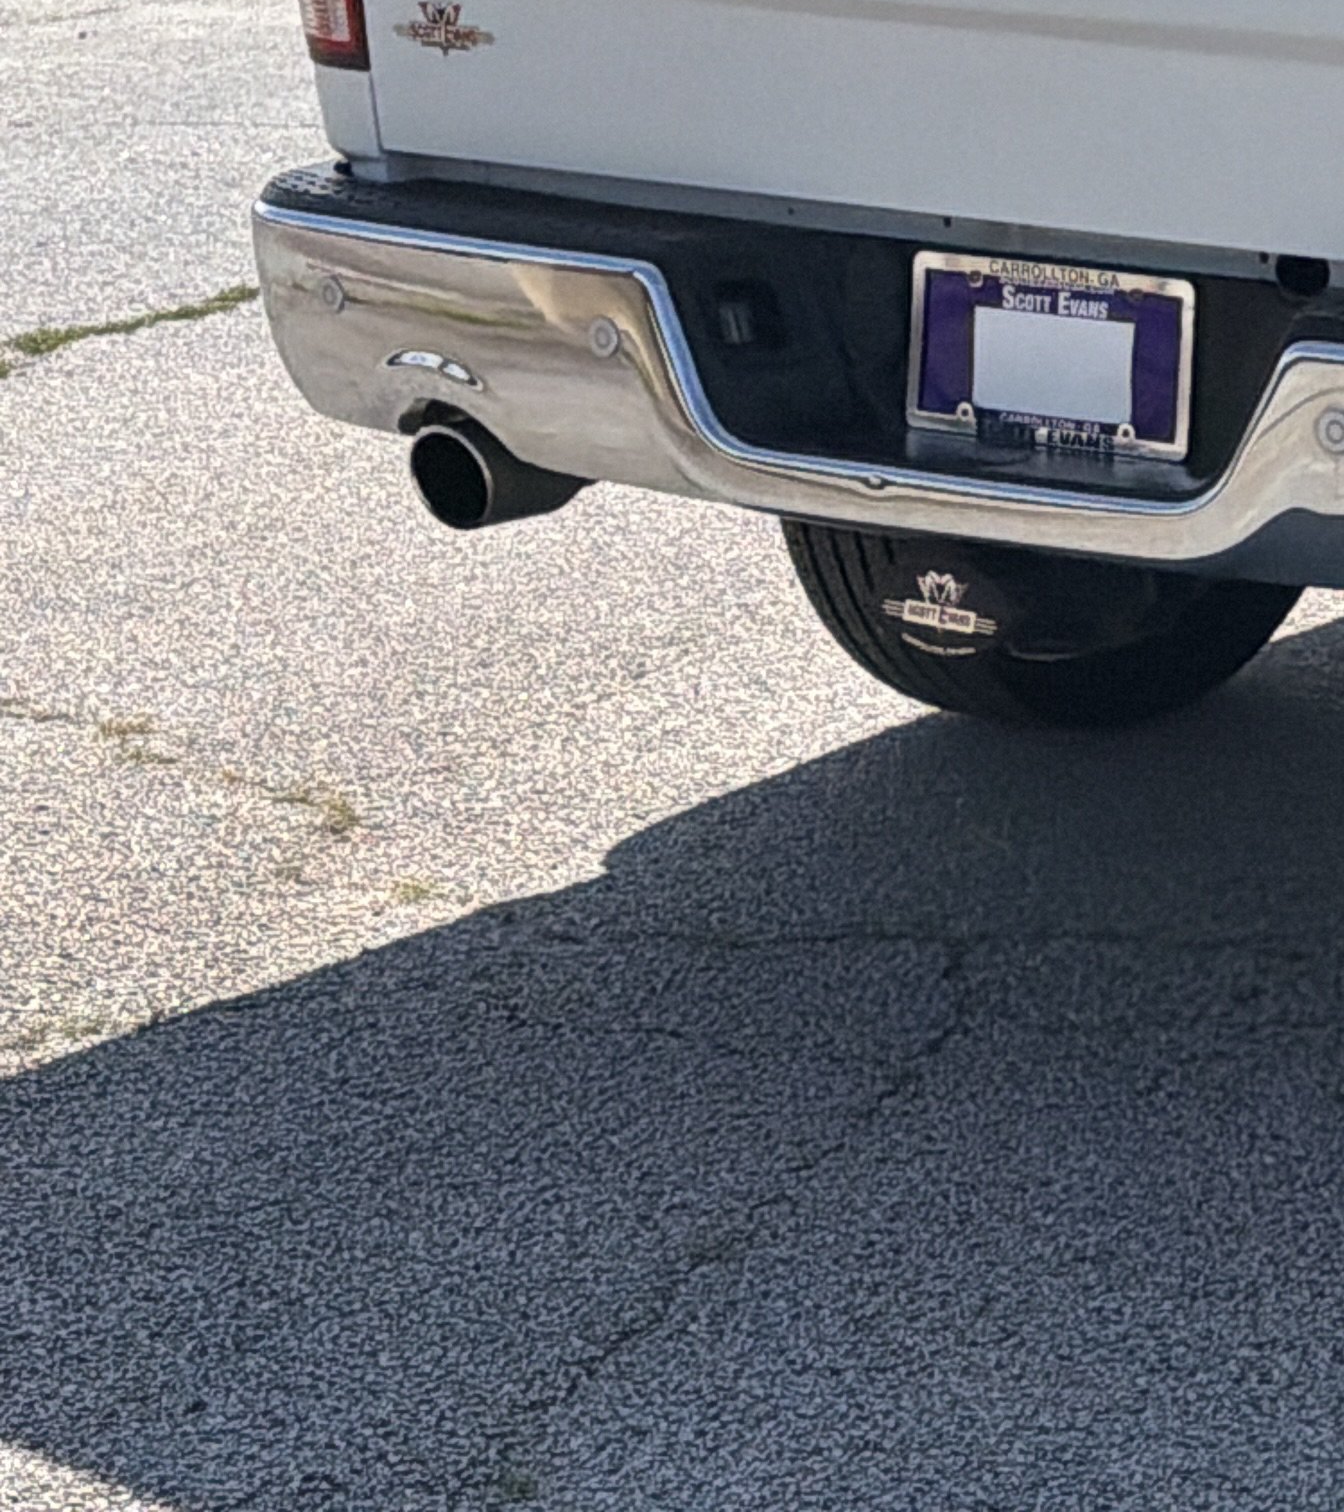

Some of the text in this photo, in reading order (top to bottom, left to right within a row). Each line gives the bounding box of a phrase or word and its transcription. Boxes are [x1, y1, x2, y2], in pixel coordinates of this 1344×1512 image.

[1096, 272, 1121, 288] GA
[1001, 284, 1052, 312] SCOTT
[1057, 290, 1110, 319] EVANS
